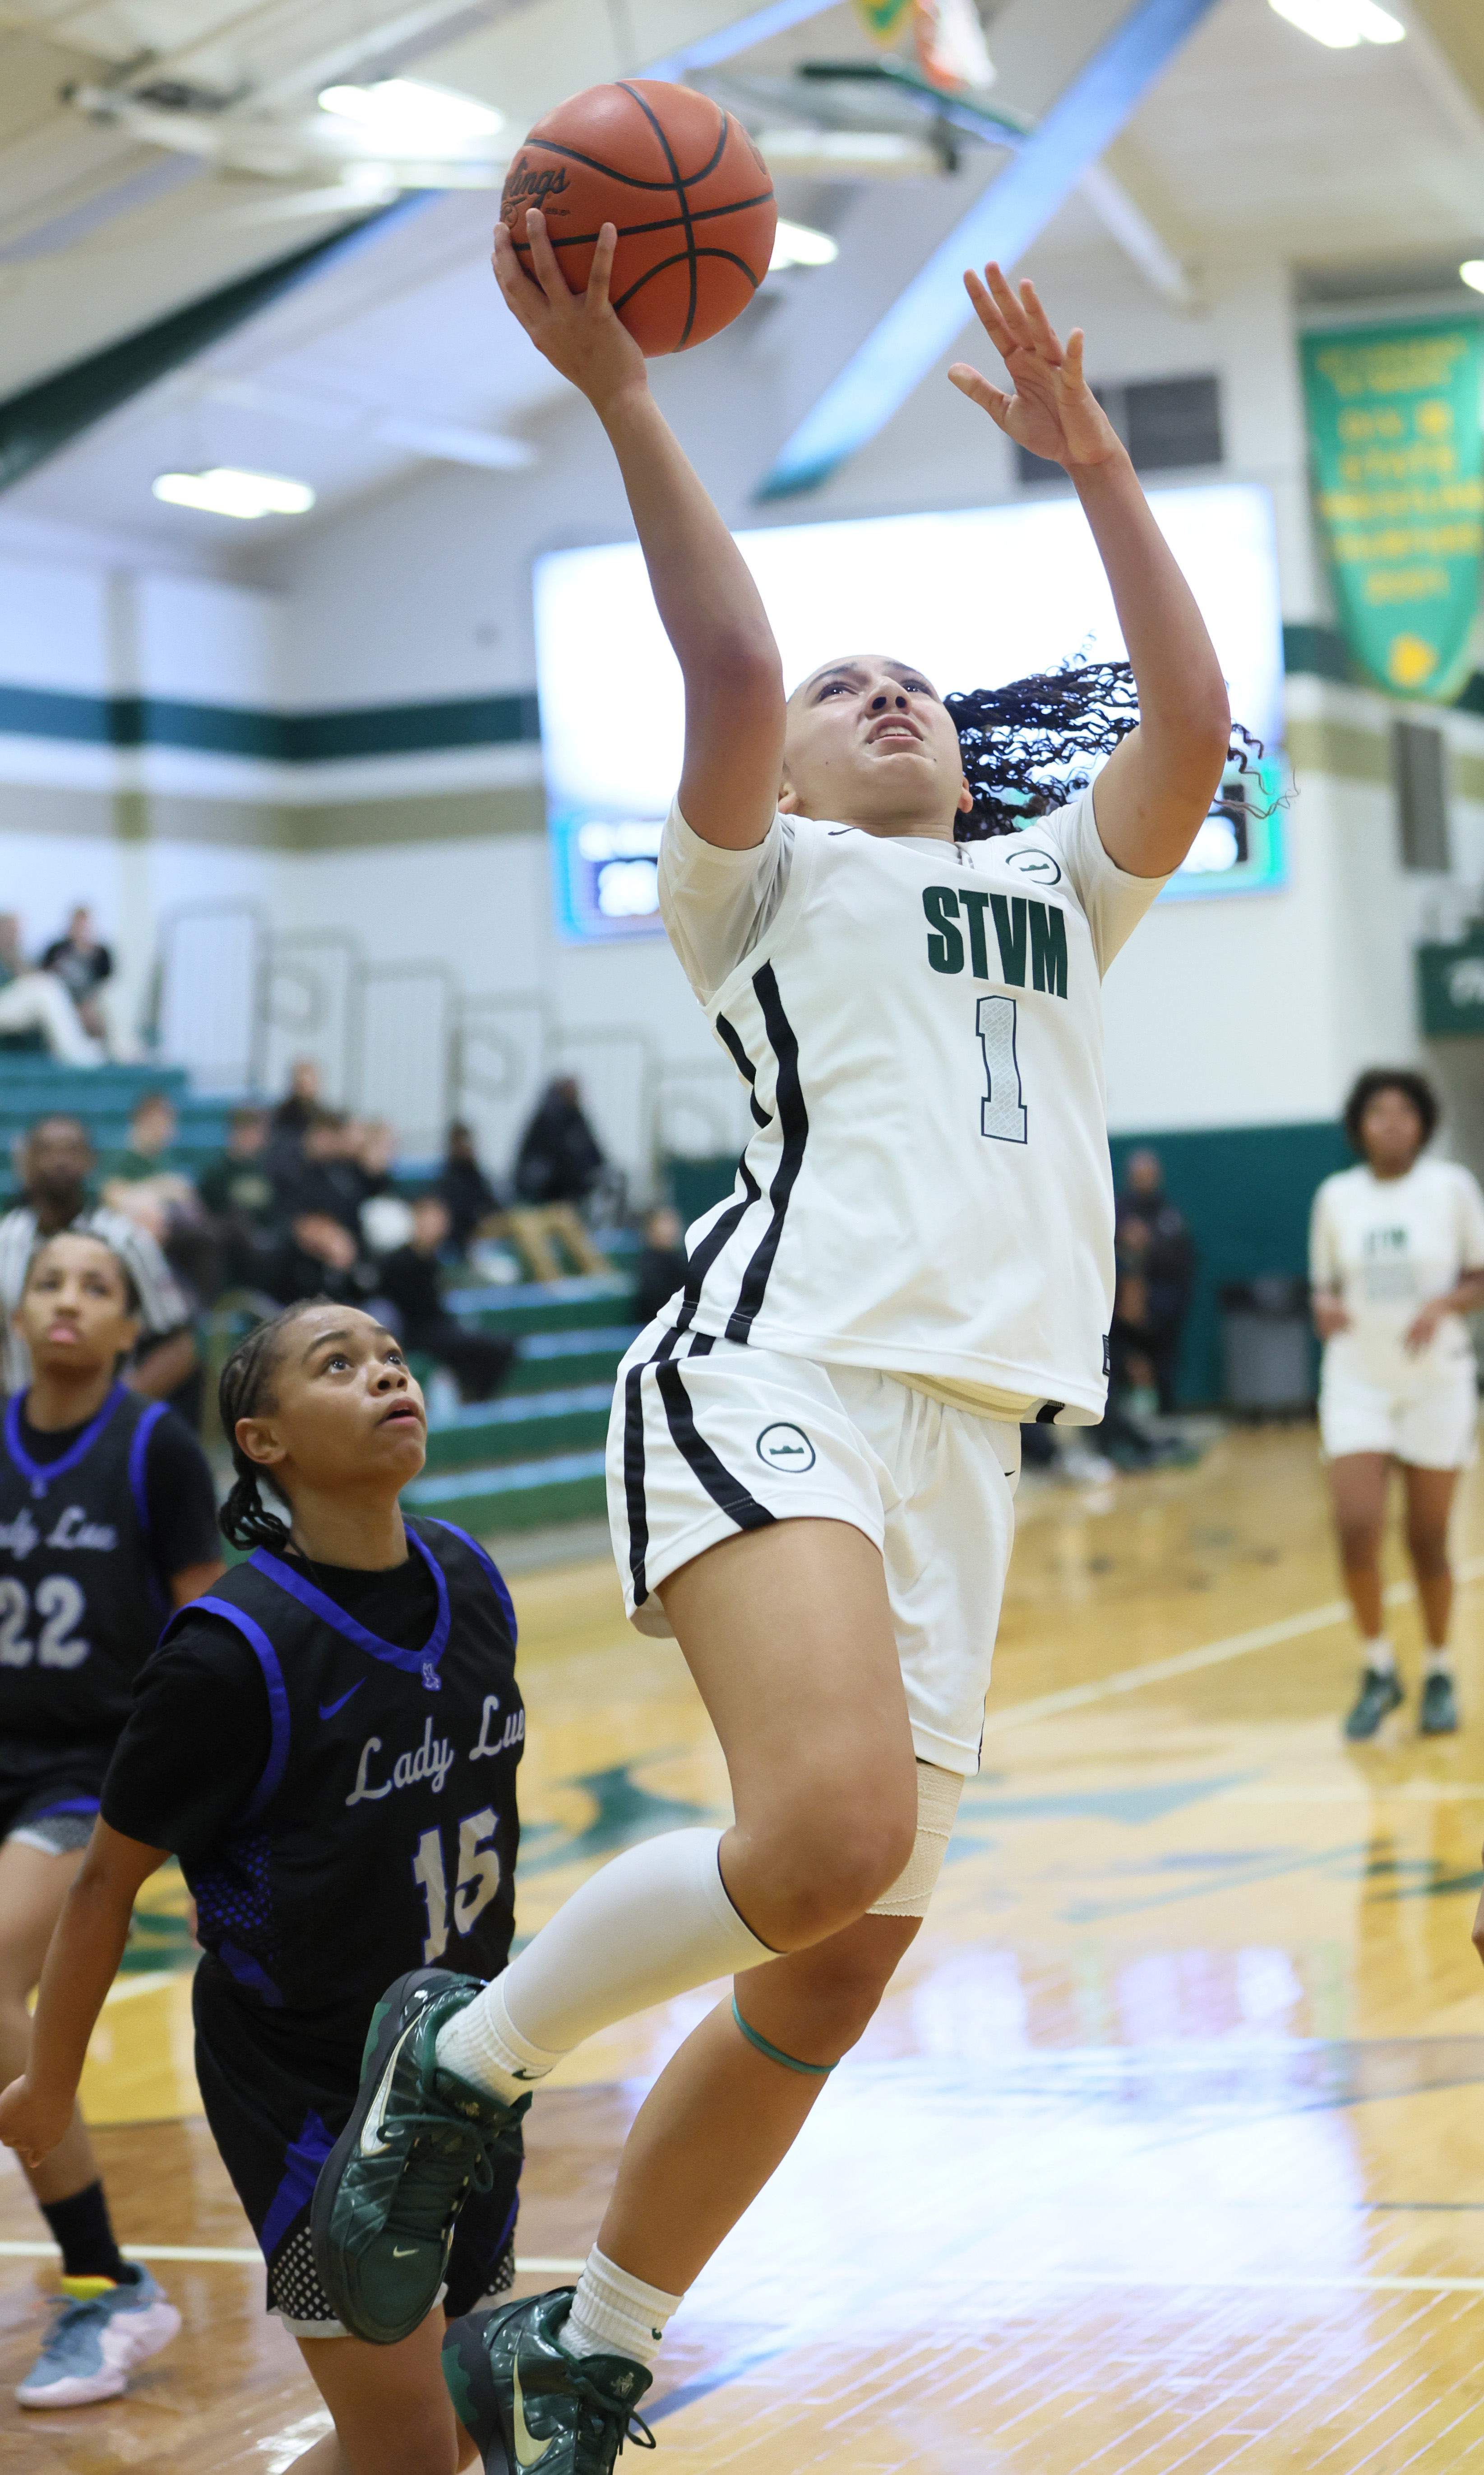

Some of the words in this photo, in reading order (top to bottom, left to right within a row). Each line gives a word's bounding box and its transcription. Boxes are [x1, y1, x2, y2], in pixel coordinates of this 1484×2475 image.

[503, 157, 570, 209] lings
[922, 886, 1068, 1000] STVM
[975, 995, 1027, 1144] 1
[0, 1573, 89, 1669] 22
[345, 1716, 455, 1806] Lady
[411, 1804, 500, 1967] 15
